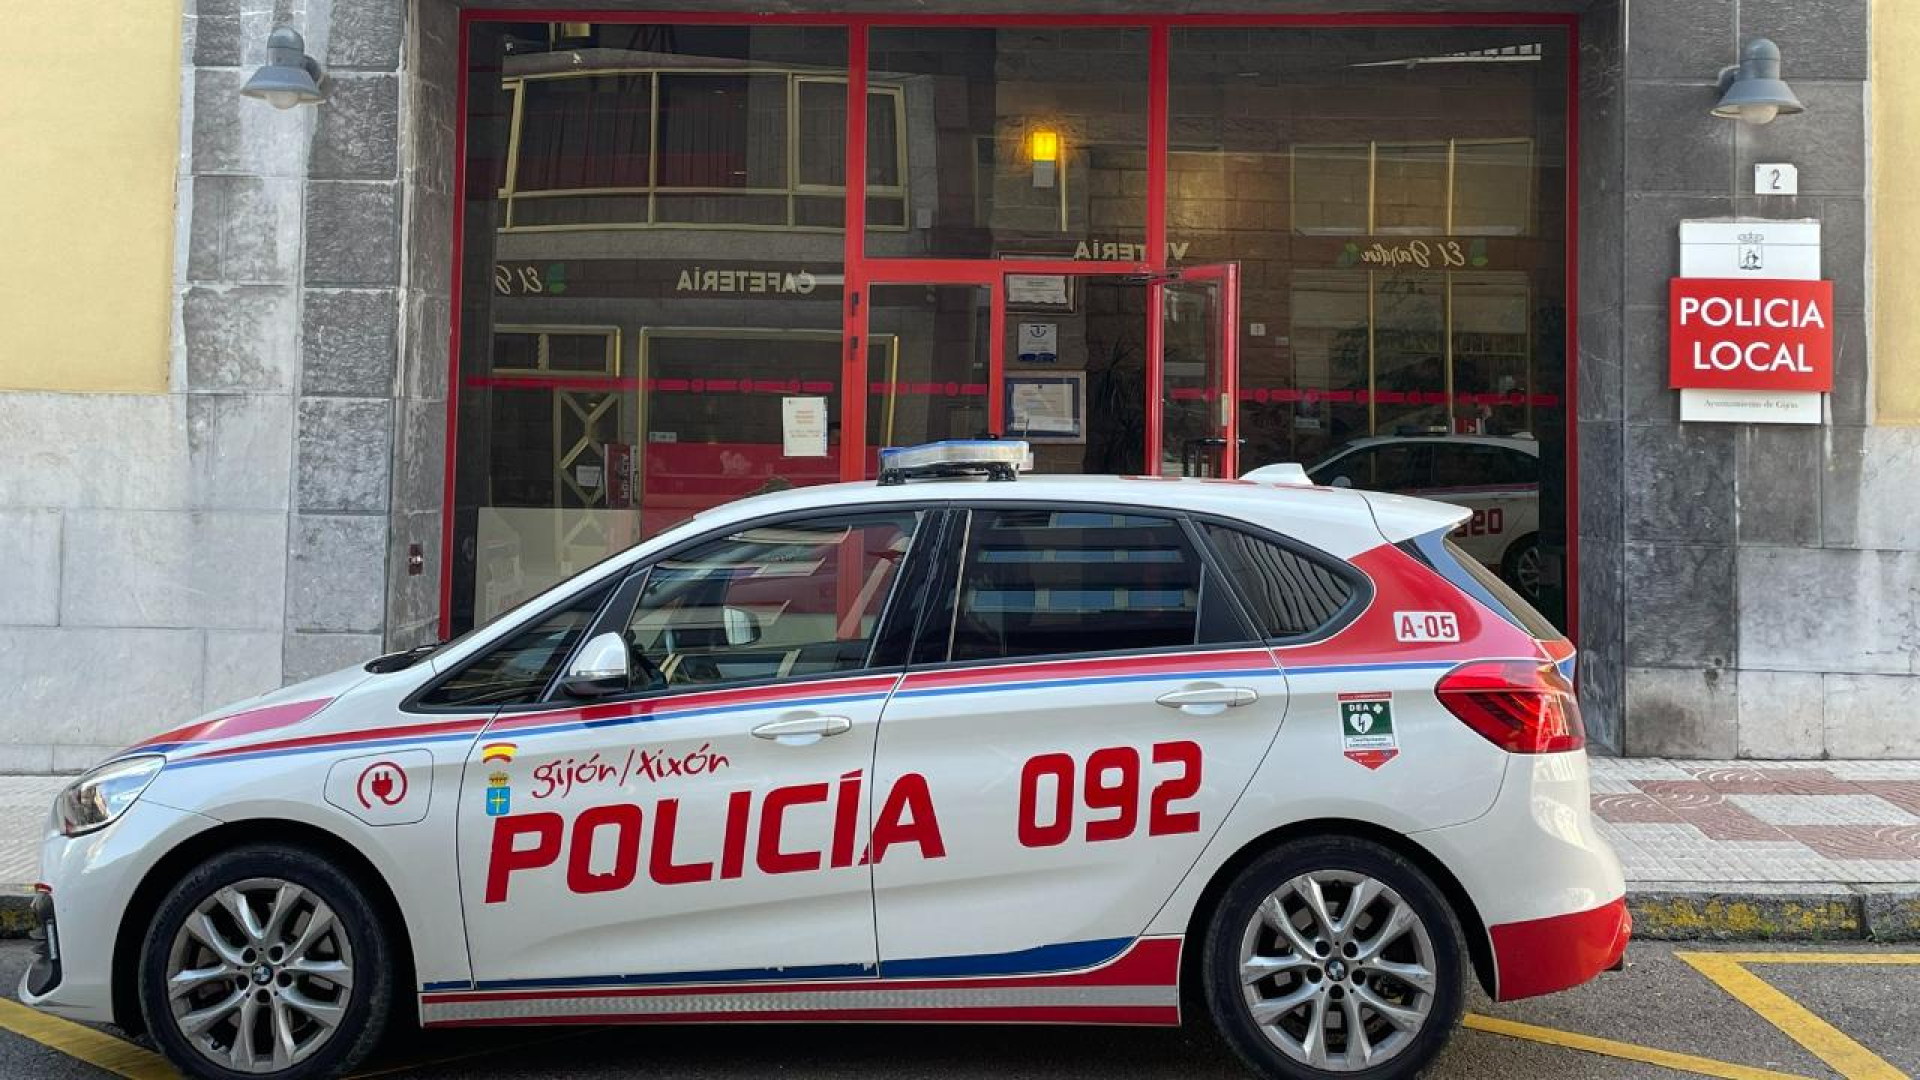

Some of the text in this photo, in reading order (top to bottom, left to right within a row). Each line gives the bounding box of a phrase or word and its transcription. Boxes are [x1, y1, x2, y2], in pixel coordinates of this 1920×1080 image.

[1770, 168, 1782, 190] 2
[1680, 297, 1825, 328] POLICIA
[1693, 341, 1813, 373] LOCAL
[1401, 615, 1456, 638] A-05
[1349, 704, 1369, 712] DEA
[485, 740, 1203, 904] POLICÍA 092
